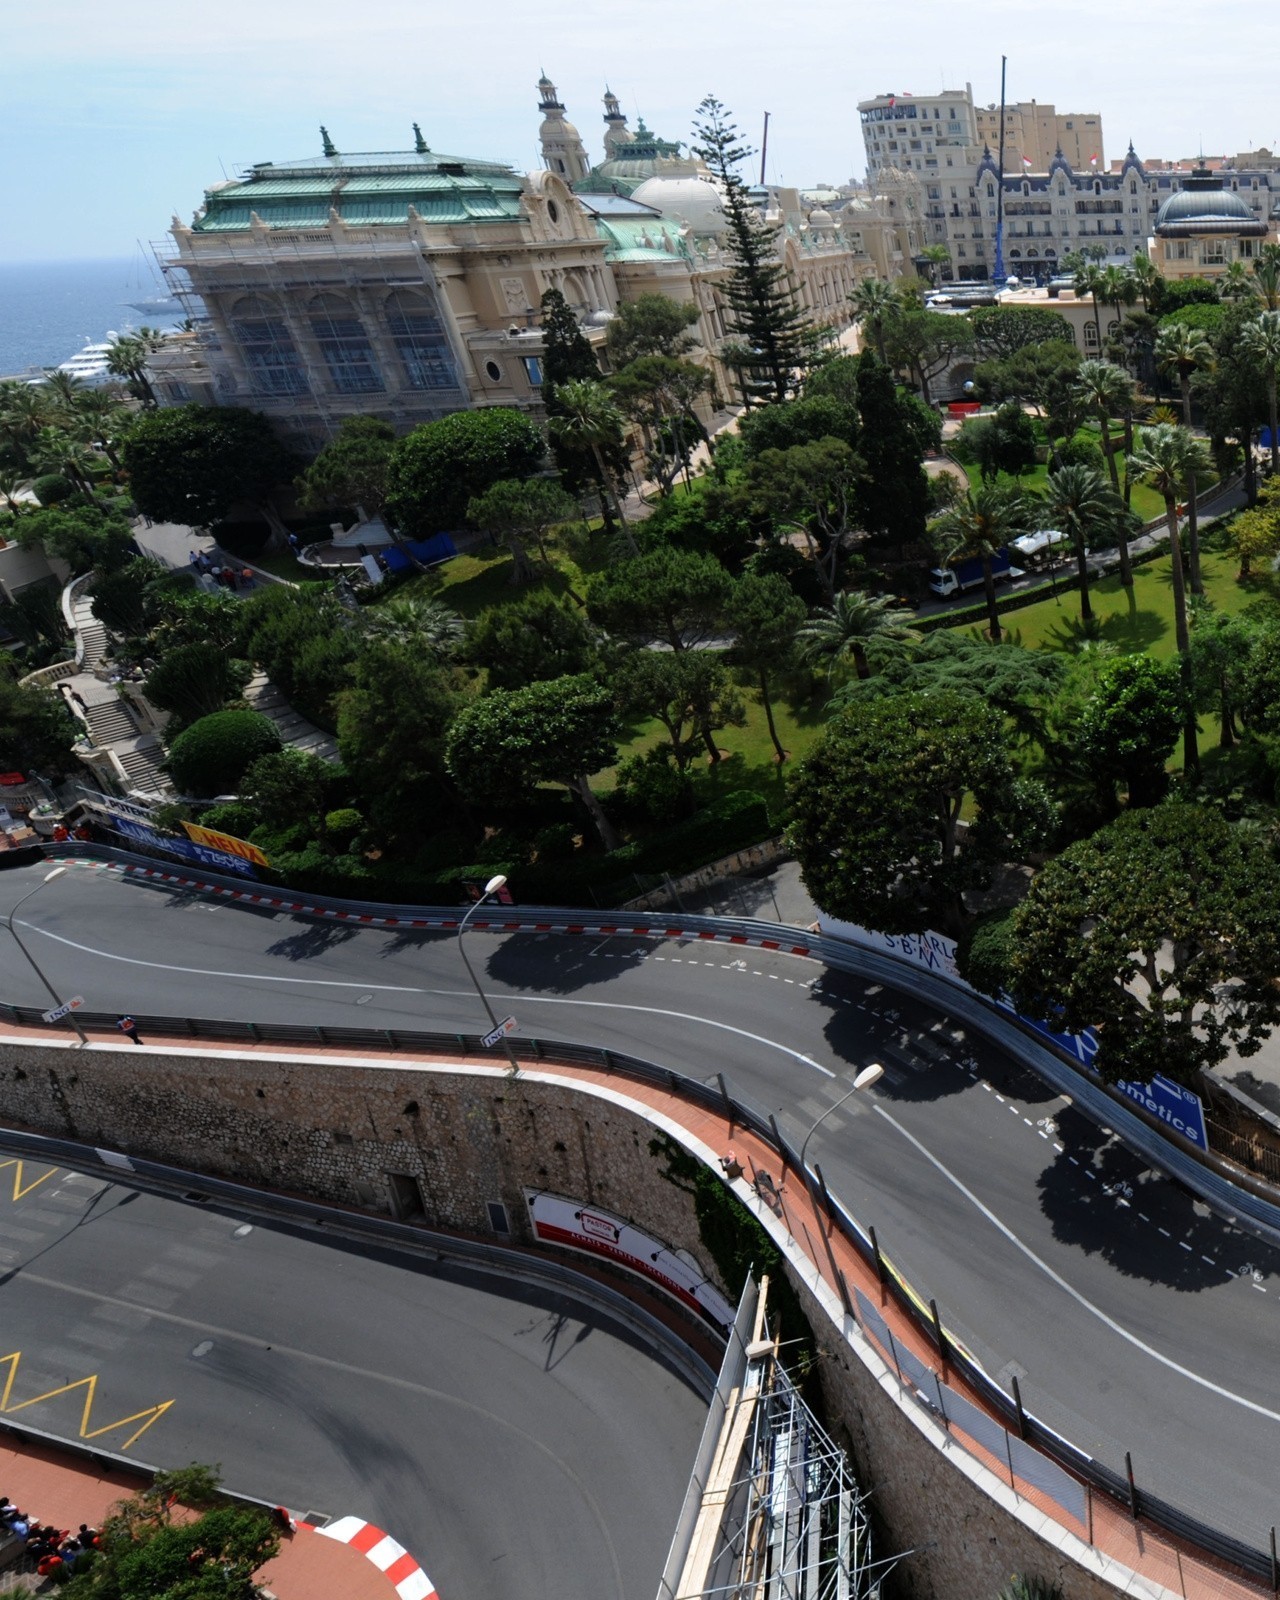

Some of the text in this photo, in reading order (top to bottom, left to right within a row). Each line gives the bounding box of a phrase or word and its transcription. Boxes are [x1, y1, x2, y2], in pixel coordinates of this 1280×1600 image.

[203, 832, 269, 866] HELIX
[50, 1006, 70, 1020] ING
[487, 1029, 504, 1044] ING
[1117, 1078, 1198, 1141] smetics
[586, 1218, 612, 1233] PASTOR
